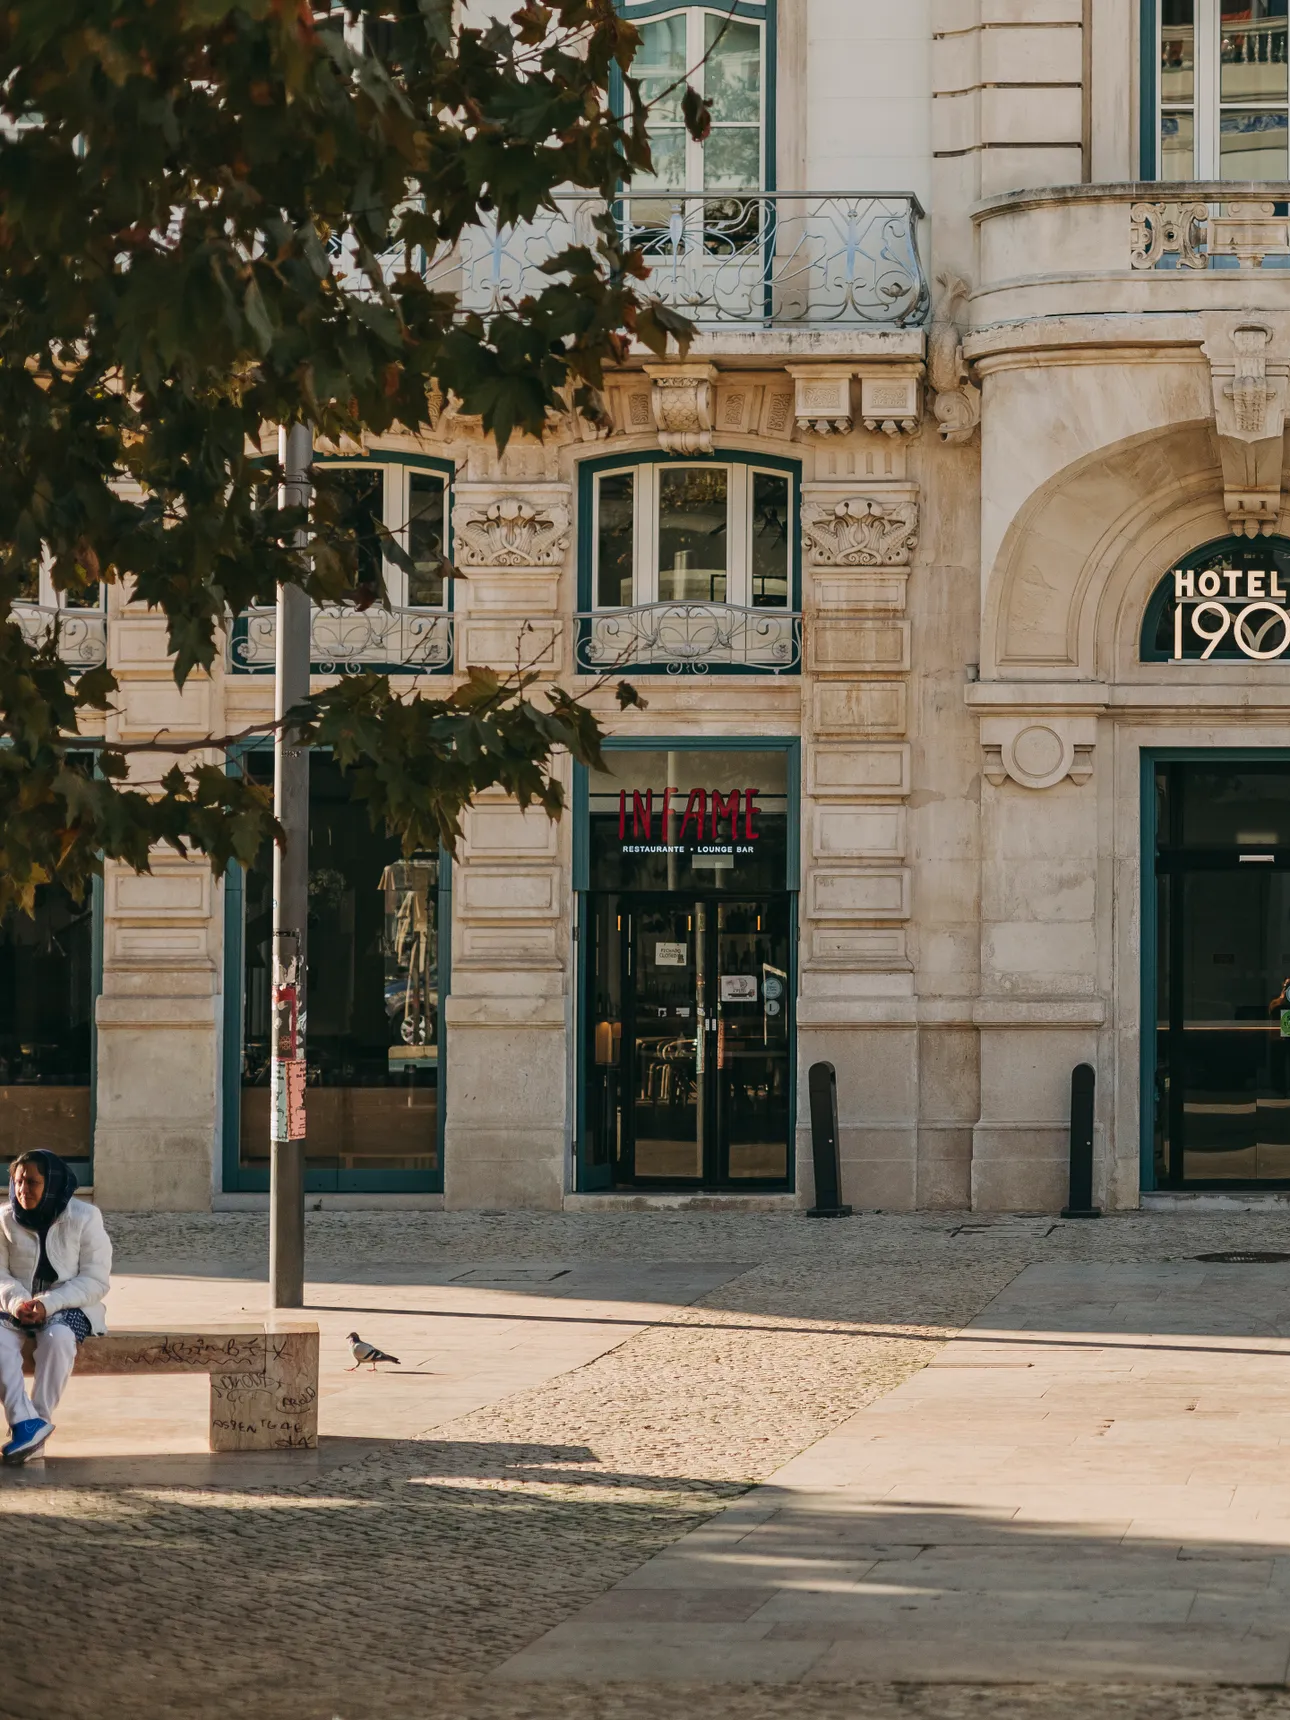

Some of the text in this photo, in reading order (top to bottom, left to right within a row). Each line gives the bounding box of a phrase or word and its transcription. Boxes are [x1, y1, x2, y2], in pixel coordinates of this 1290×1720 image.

[1175, 570, 1287, 597] HOTEL
[618, 787, 762, 843] INFAME
[622, 845, 754, 853] RESTAURANTE LOUNGE BAR
[769, 1003, 776, 1011] L
